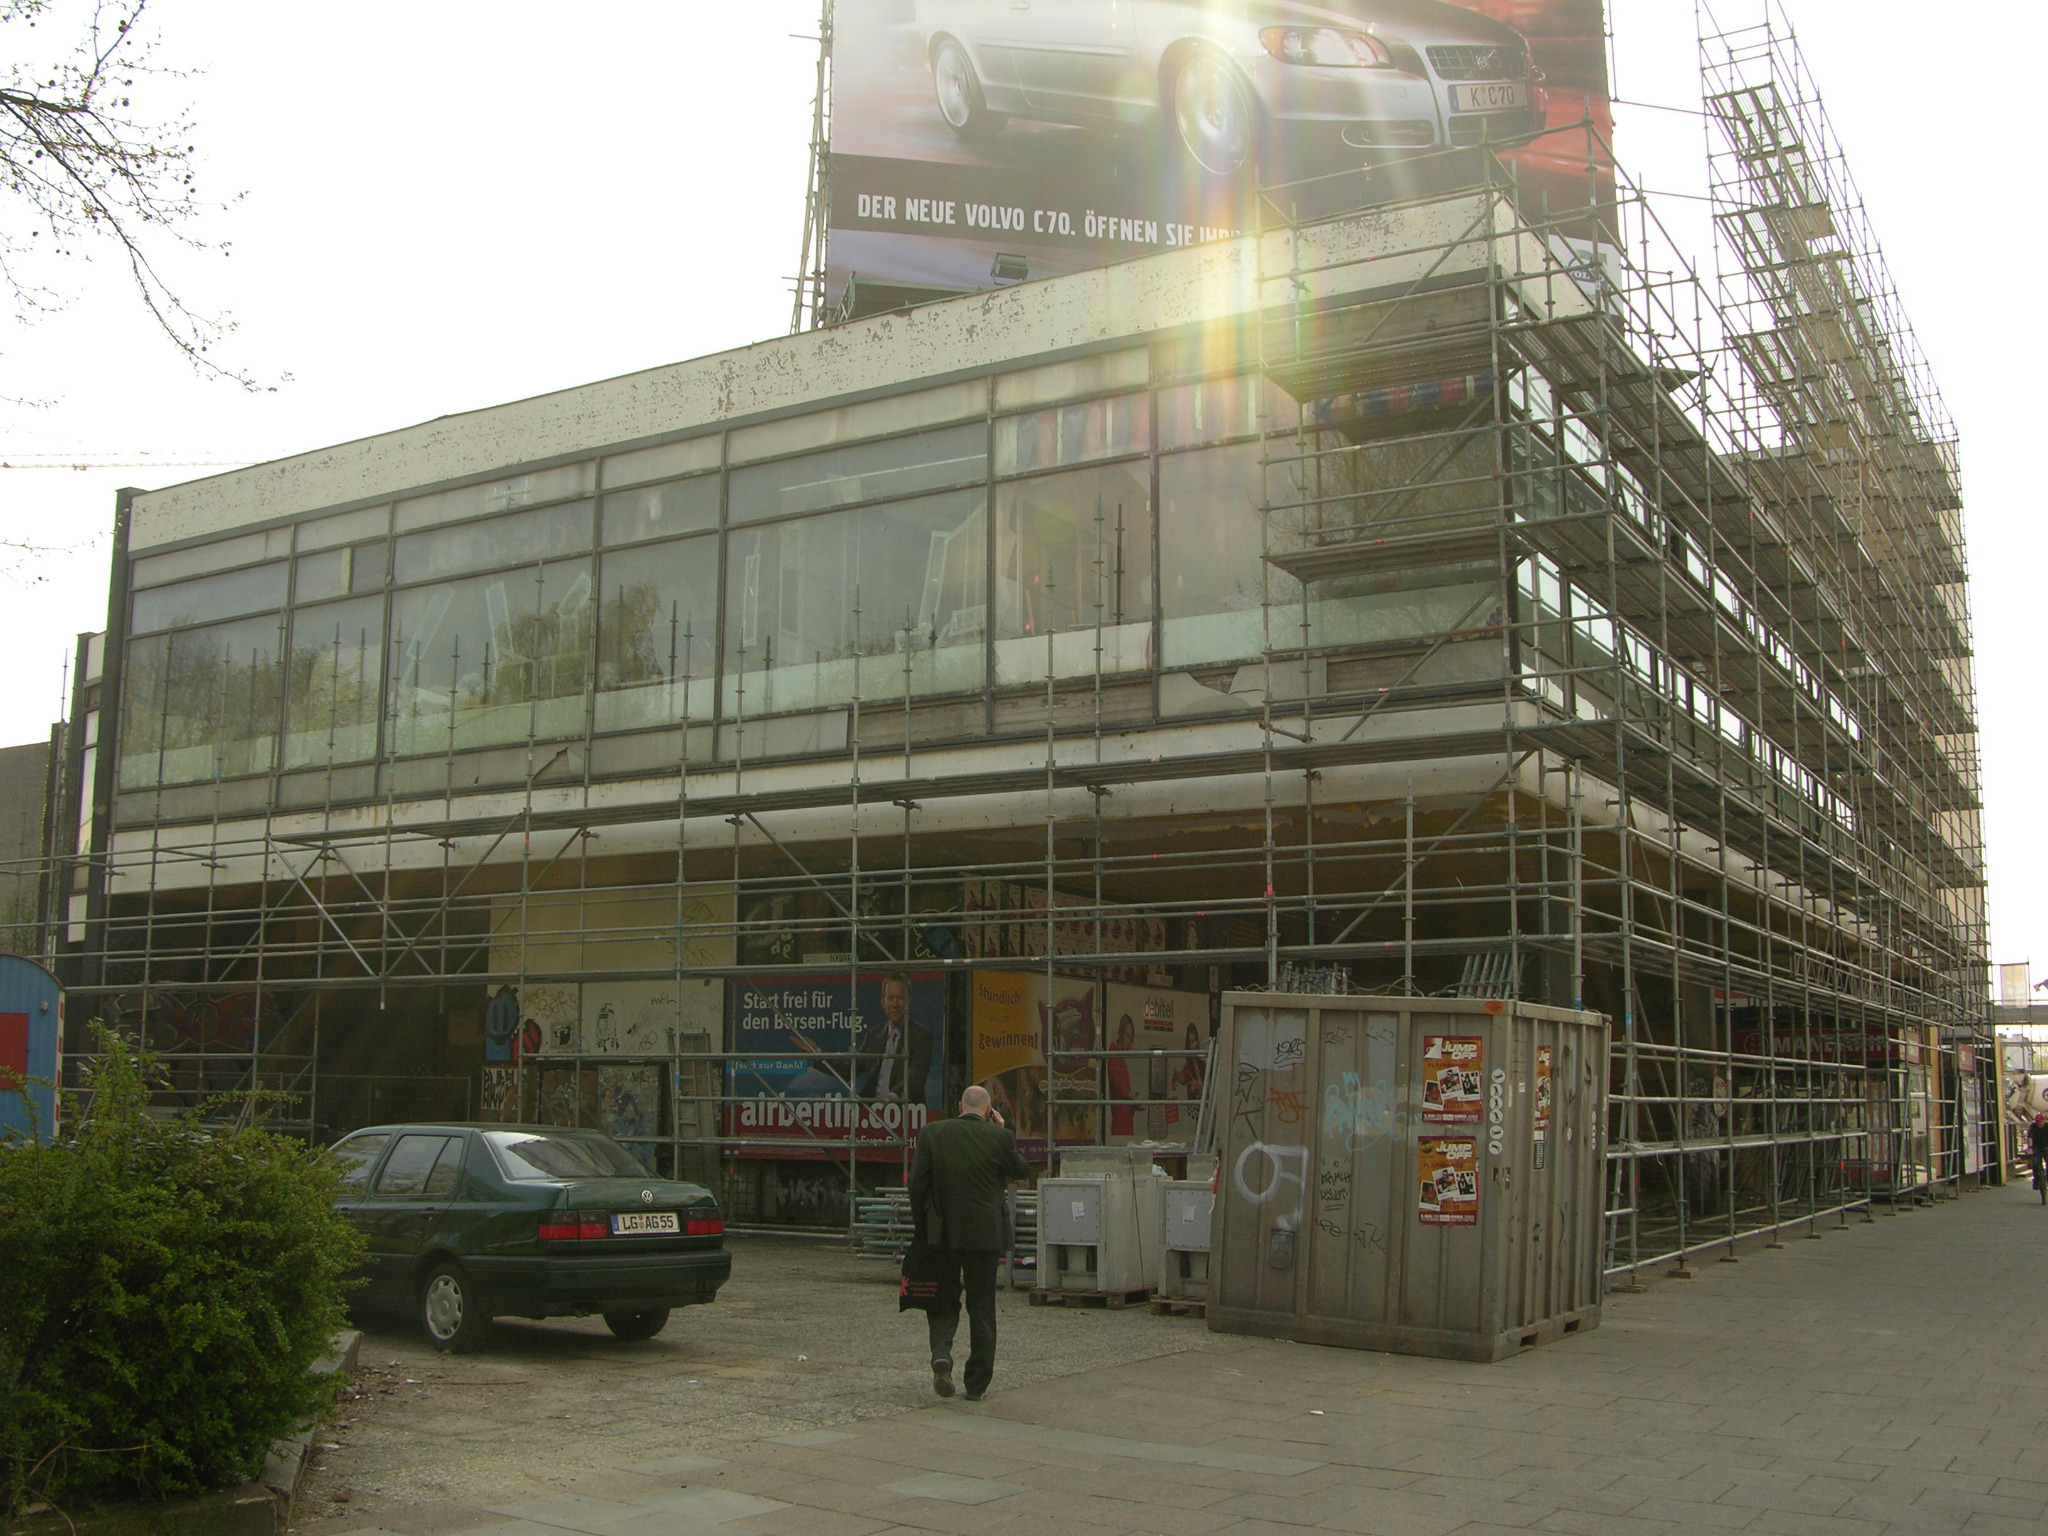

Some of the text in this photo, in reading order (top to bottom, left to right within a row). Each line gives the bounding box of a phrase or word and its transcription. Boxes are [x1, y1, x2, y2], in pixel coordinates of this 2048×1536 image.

[857, 194, 896, 220] DER
[905, 198, 956, 225] NEUE
[965, 203, 1025, 231] VOLVO
[1084, 210, 1158, 244] ÖFFNEN
[1165, 223, 1194, 246] SIE
[1570, 270, 1605, 282] OLO
[743, 990, 833, 1009] Start frei für
[978, 983, 1021, 1005] Stündlich
[1144, 997, 1174, 1018] debitel
[742, 1011, 868, 1033] den Börsen-Flug.
[978, 1031, 1038, 1051] gewinnen!
[1451, 1051, 1478, 1060] OFF
[758, 1062, 774, 1070] zur
[740, 1091, 928, 1130] airberlin.com
[1445, 1151, 1473, 1160] OFF
[622, 1216, 638, 1230] LG
